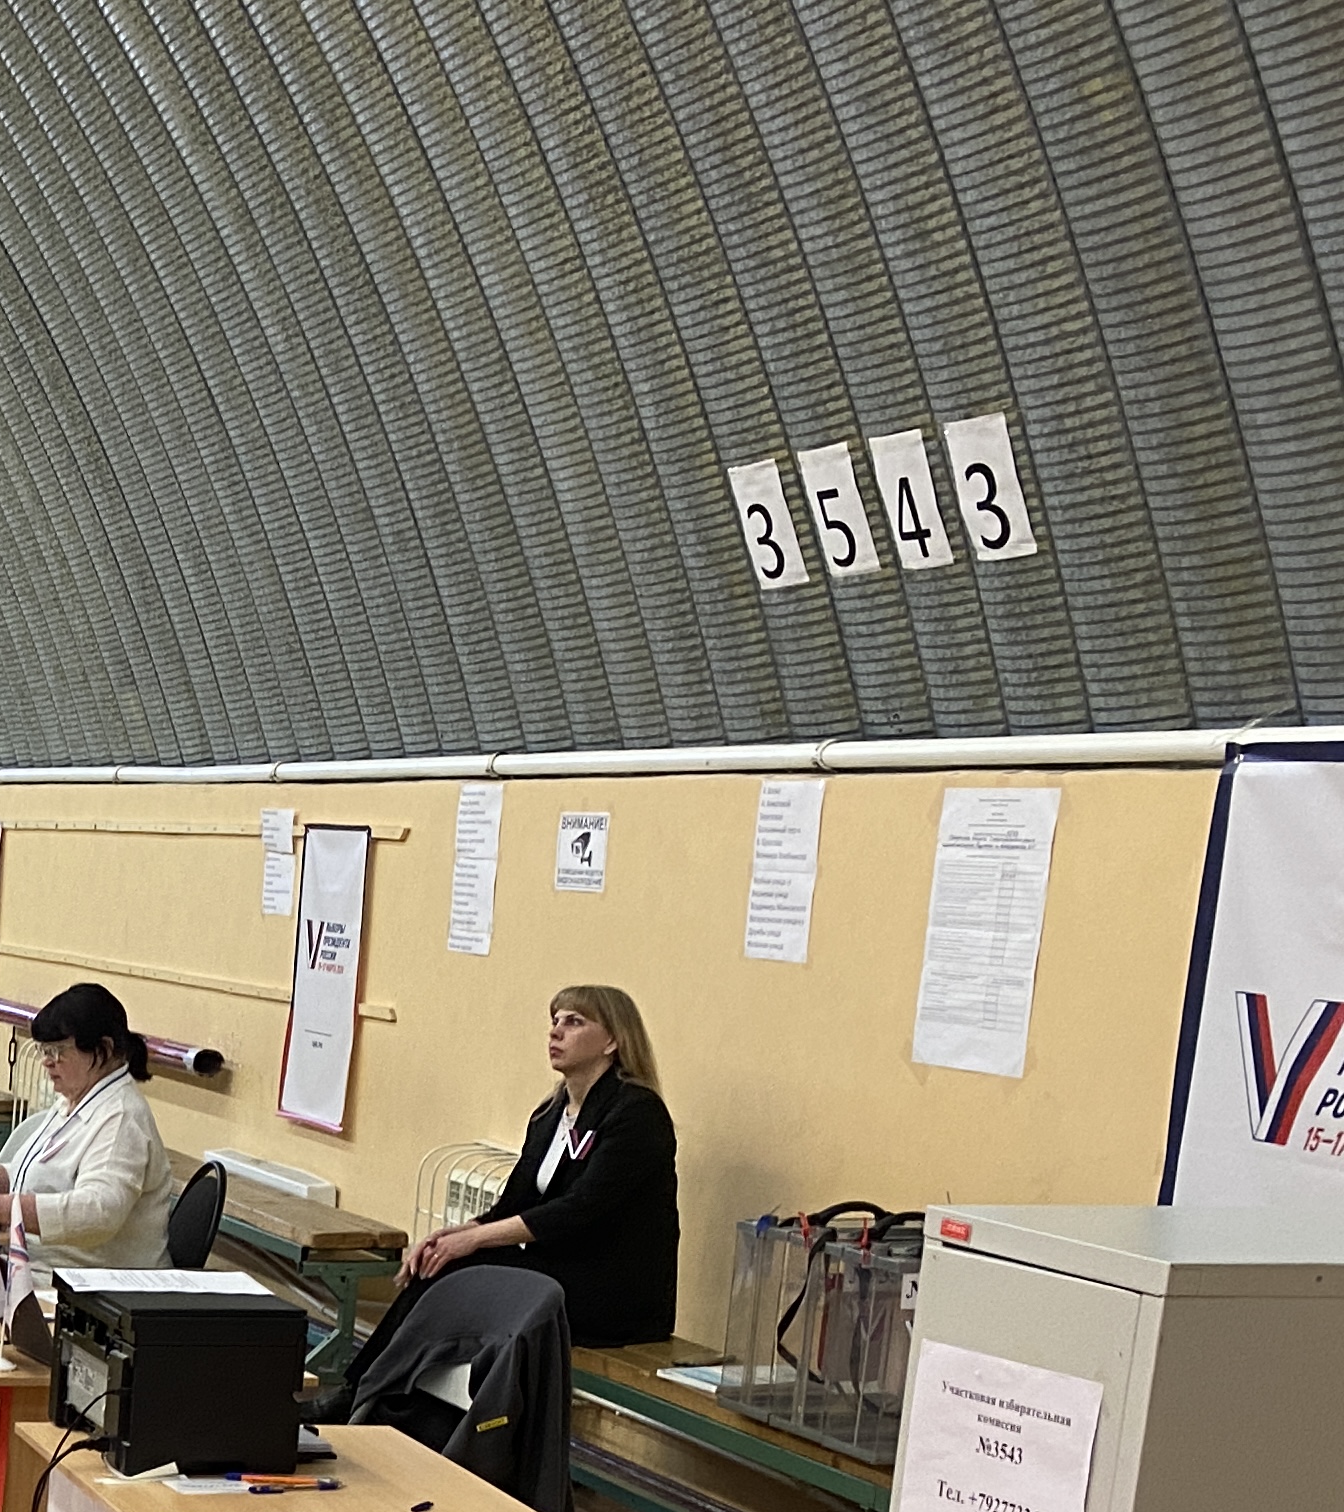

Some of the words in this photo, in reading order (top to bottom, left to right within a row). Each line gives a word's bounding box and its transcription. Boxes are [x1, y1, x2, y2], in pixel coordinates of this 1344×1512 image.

[942, 1380, 996, 1406] Участковая
[998, 1398, 1072, 1427] избирательная
[977, 1414, 1022, 1434] комиссия
[975, 1436, 1023, 1465] №3543
[937, 1478, 964, 1504] Тел.
